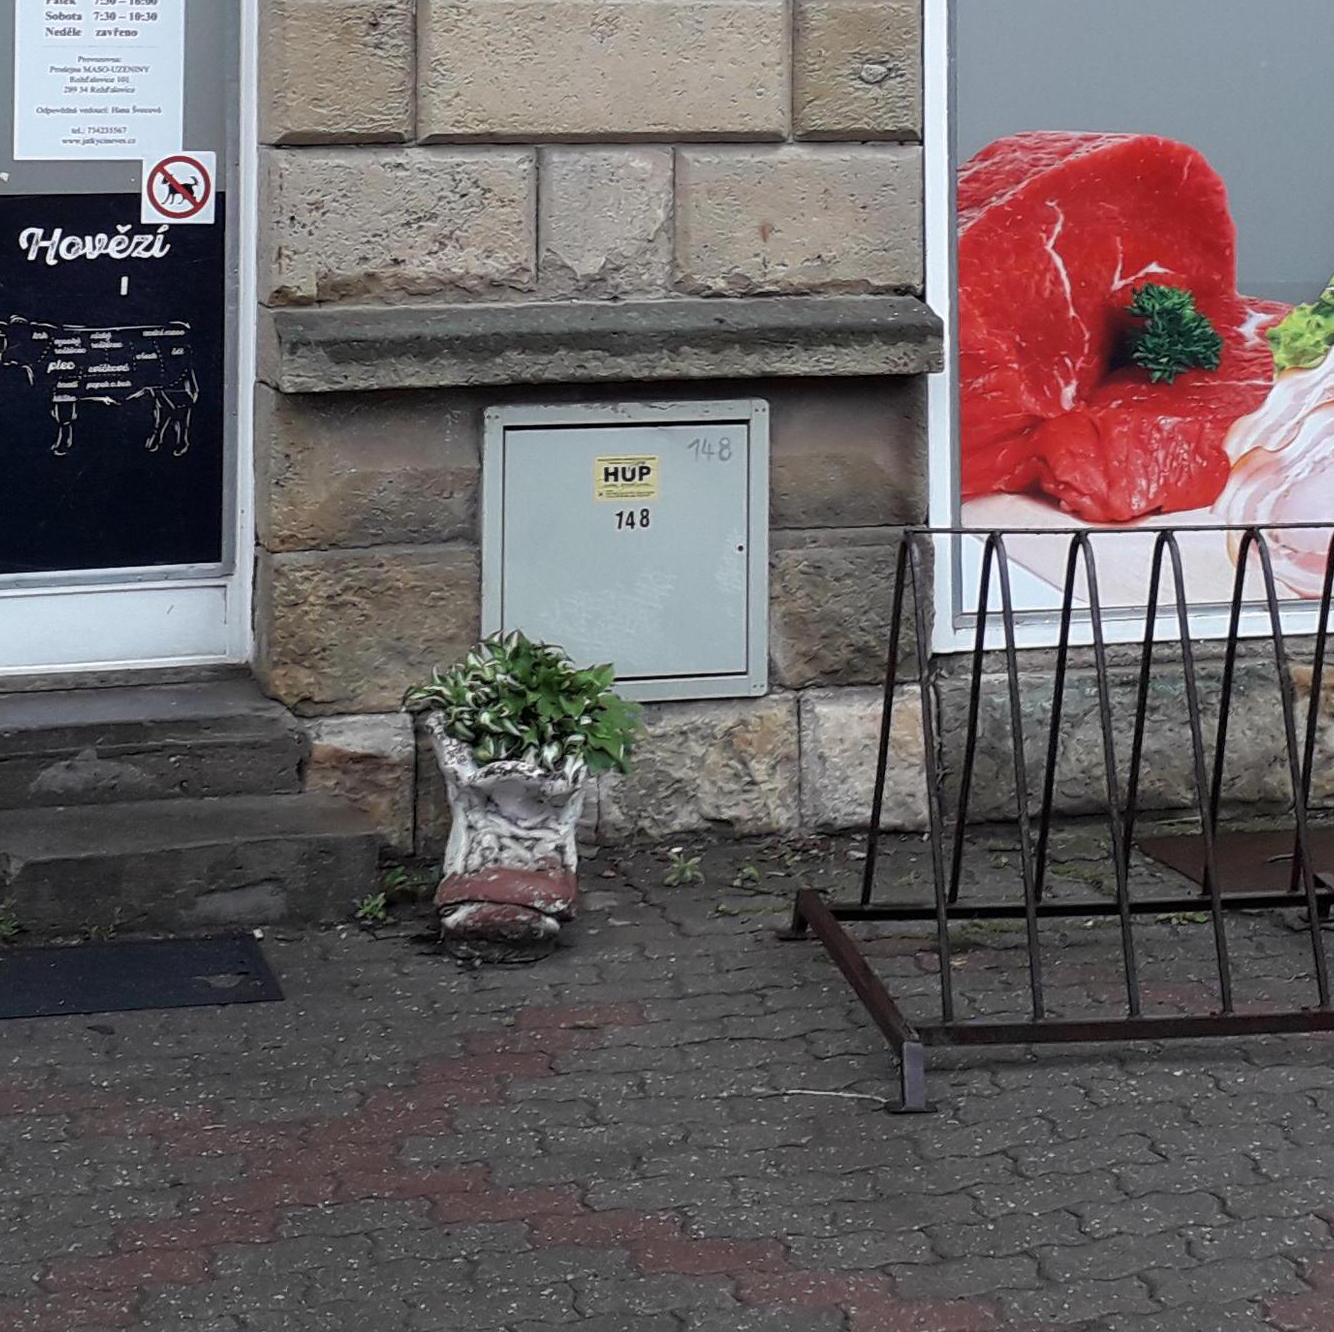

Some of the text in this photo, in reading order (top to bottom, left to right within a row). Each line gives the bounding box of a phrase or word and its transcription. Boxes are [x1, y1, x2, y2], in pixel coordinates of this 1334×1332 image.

[45, 10, 83, 22] Sobota
[93, 11, 117, 21] 7:30
[129, 12, 158, 22] 10:30
[45, 26, 139, 38] Neděle zavřeno
[18, 223, 172, 267] Hovězí
[47, 359, 76, 374] plec
[686, 436, 733, 463] 148
[603, 465, 652, 483] HUP
[614, 507, 651, 530] 148
